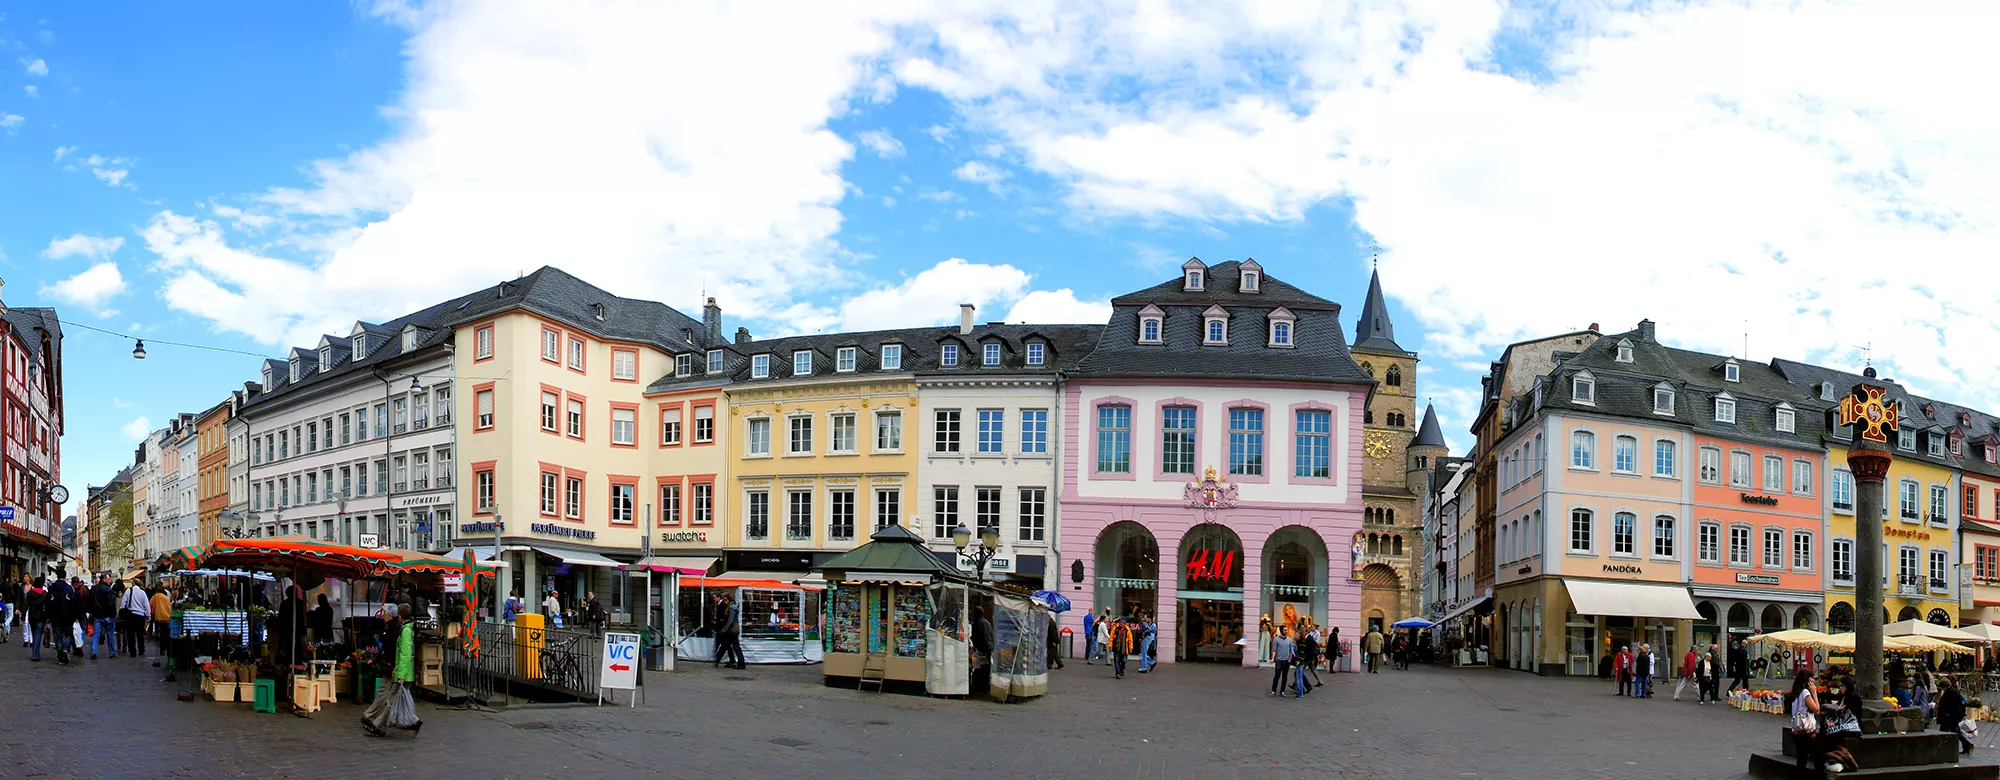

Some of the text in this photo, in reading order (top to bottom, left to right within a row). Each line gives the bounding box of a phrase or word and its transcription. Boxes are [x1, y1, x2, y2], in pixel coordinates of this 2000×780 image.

[1740, 492, 1778, 506] Teestube
[662, 531, 699, 542] swatch
[1884, 525, 1931, 540] Domstein
[362, 536, 376, 545] WC
[1185, 548, 1235, 583] H&M
[1602, 564, 1642, 573] PANDORA
